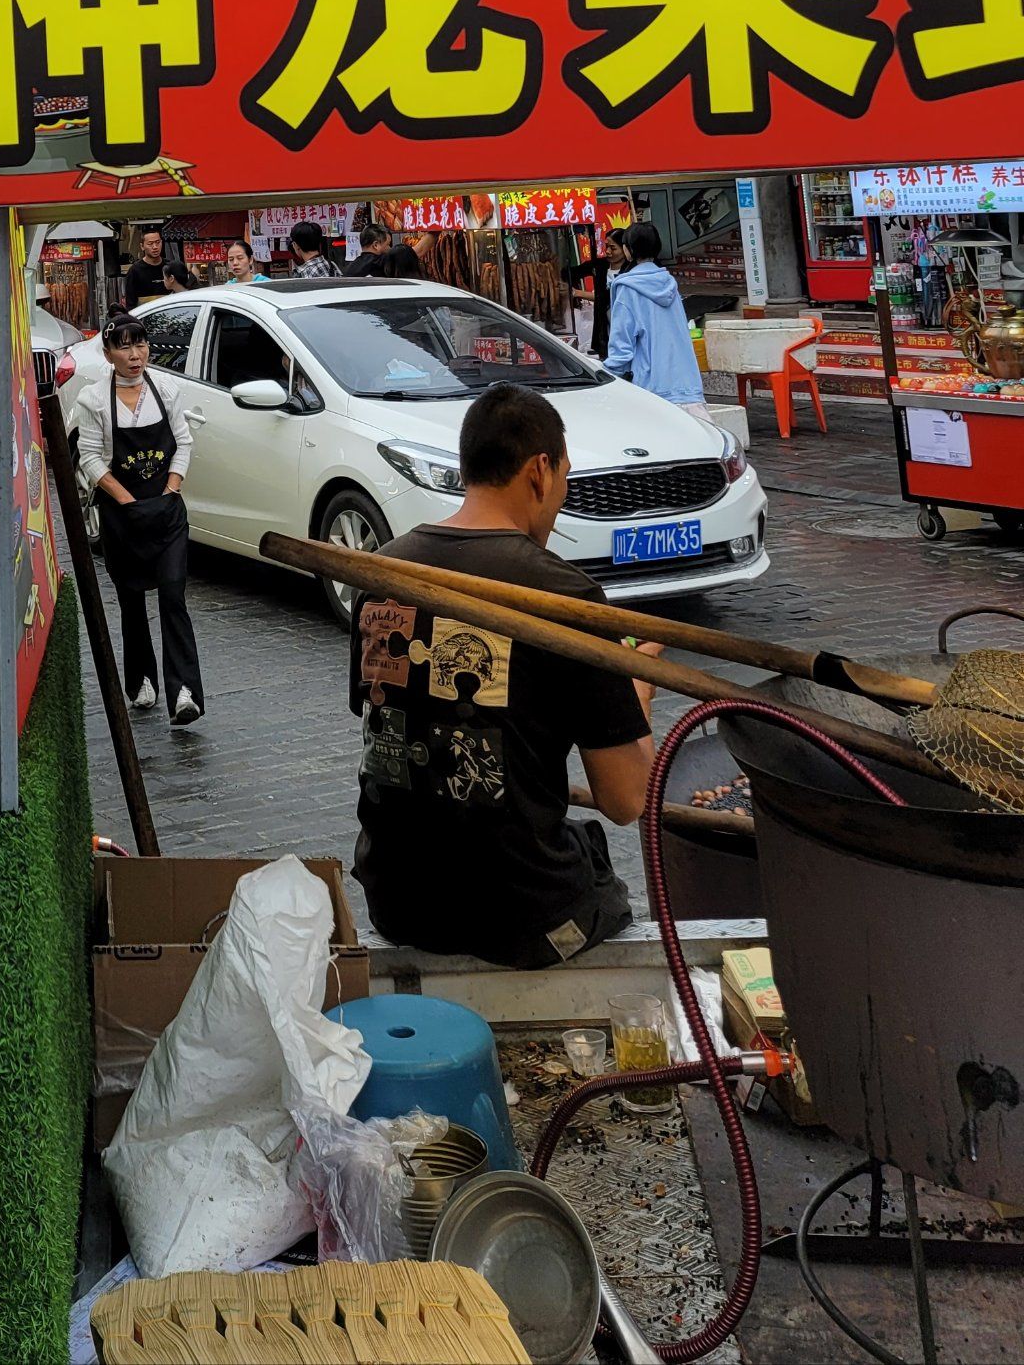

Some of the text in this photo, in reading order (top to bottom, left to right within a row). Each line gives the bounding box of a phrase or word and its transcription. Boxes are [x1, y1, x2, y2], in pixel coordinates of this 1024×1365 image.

[403, 202, 464, 230] 脆皮五花肉
[504, 198, 595, 226] 脆皮五花肉
[907, 335, 947, 348] 新品上市
[873, 357, 913, 370] 新上市
[364, 609, 408, 628] GALAXY
